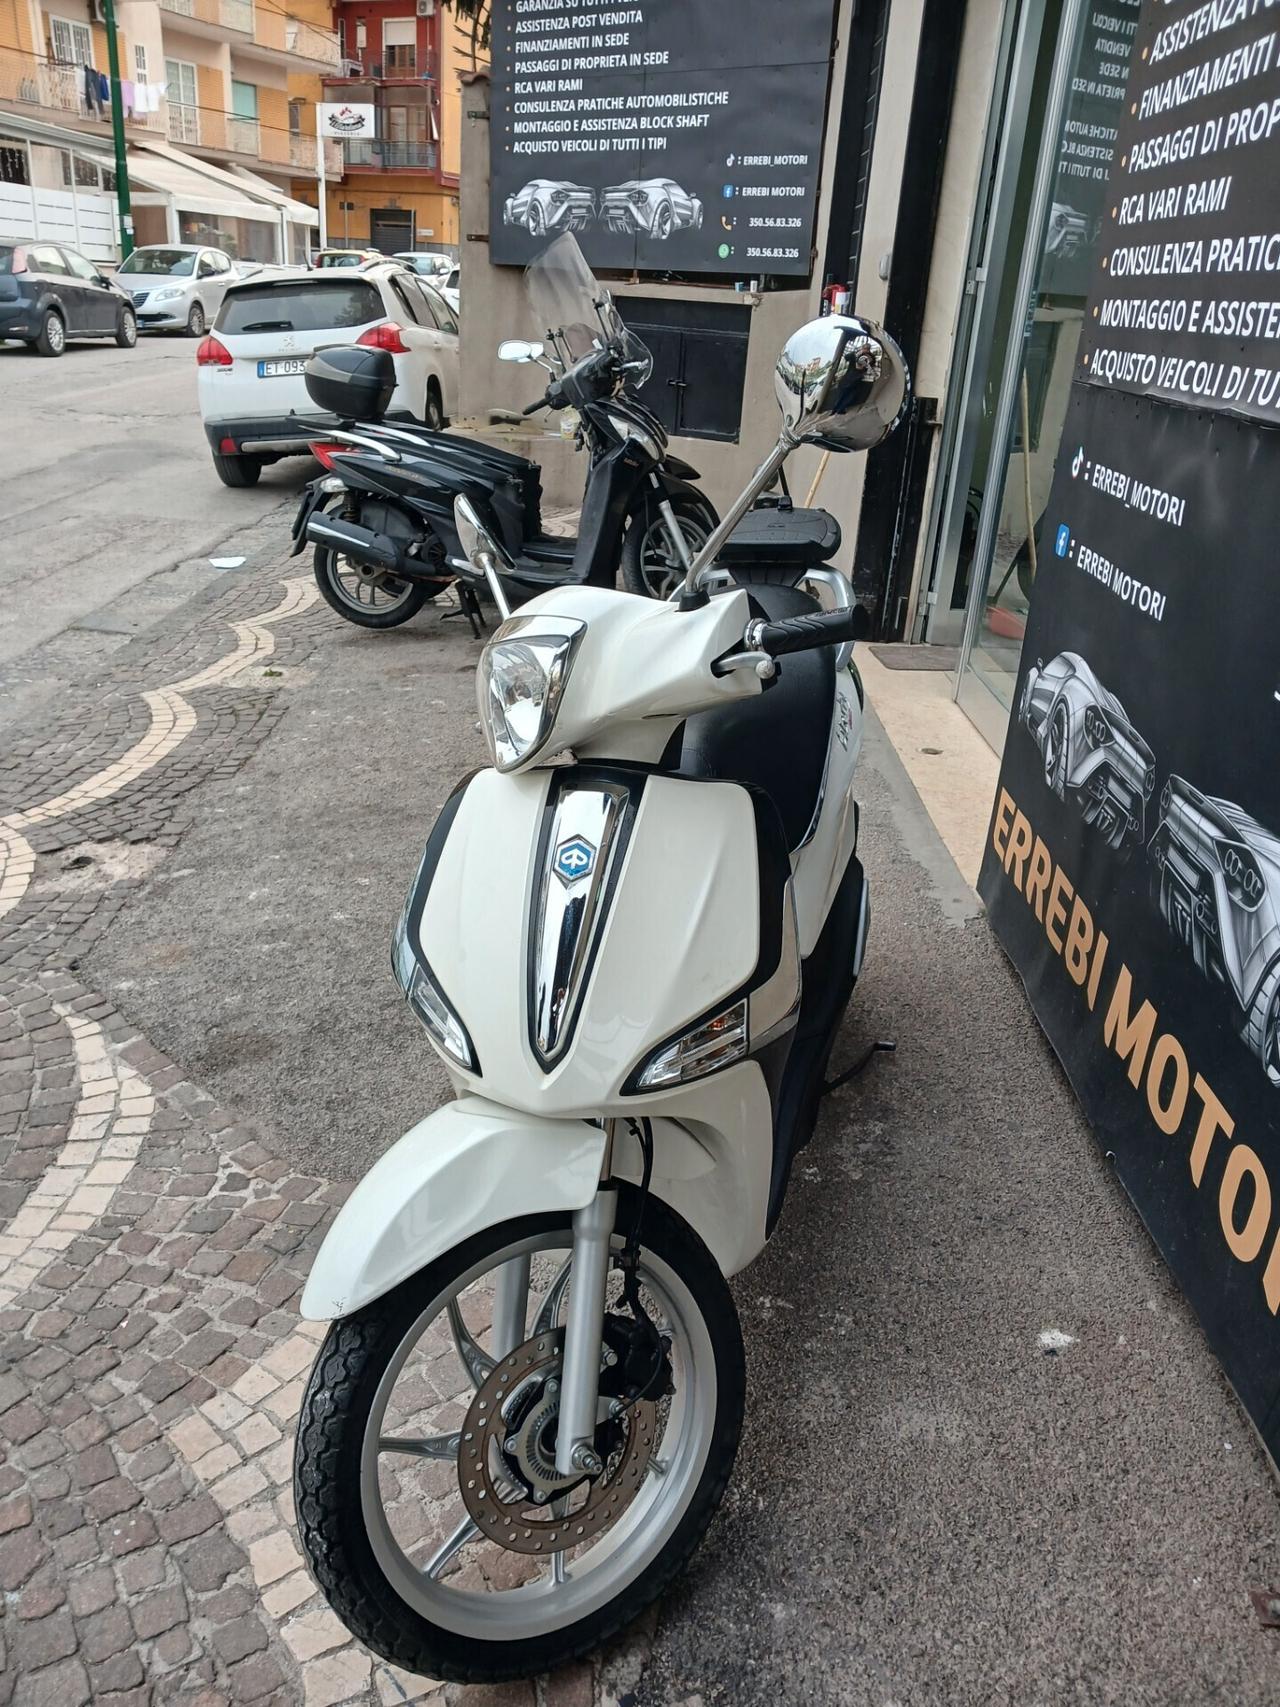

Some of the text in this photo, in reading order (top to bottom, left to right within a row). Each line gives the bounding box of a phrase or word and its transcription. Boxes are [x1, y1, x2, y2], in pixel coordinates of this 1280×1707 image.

[516, 0, 564, 13] GARANZIA
[515, 10, 642, 34] ASSISTENZA POST VENDITA
[1149, 0, 1247, 66] ASSISTENZA
[515, 33, 629, 53] FINANZIAMENTI IN SEDE
[515, 51, 669, 74] PASSAGGI DI PROPRIETA IN SEDE
[515, 79, 583, 94] RCA VARI RAMI
[1138, 32, 1277, 120] FINANZIAMENTI
[514, 92, 729, 114] CONSULENZA PRATICHE AUTOMOBILISTICHE
[514, 114, 709, 133] MONTAGGIO E ASSISTENZA BLOCK SHAFT
[513, 137, 667, 155] ACQUISTO VEICOLI DI TUTTI I TIPI
[1129, 124, 1200, 174] PASSAGGI
[1200, 117, 1223, 155] DI
[744, 155, 808, 166] ERREBI_MOTORI
[742, 187, 805, 196] ERREBI MOTORI
[1118, 176, 1232, 225] RCA VARI RAMI
[749, 217, 802, 227] 350.56.83.326
[746, 247, 799, 257] 350.56.83.326
[1110, 233, 1280, 276] CONSULENZA PRATIC
[1100, 300, 1280, 339] MONTAGGIO E ASSISTE
[266, 363, 280, 374] ET
[1090, 349, 1280, 409] ACQUISTO VEICOLI DI TU
[1092, 464, 1185, 526] ERREBI_MOTORI
[1077, 545, 1166, 622] ERREBI MOTORI
[994, 786, 1108, 1011] ERREBI
